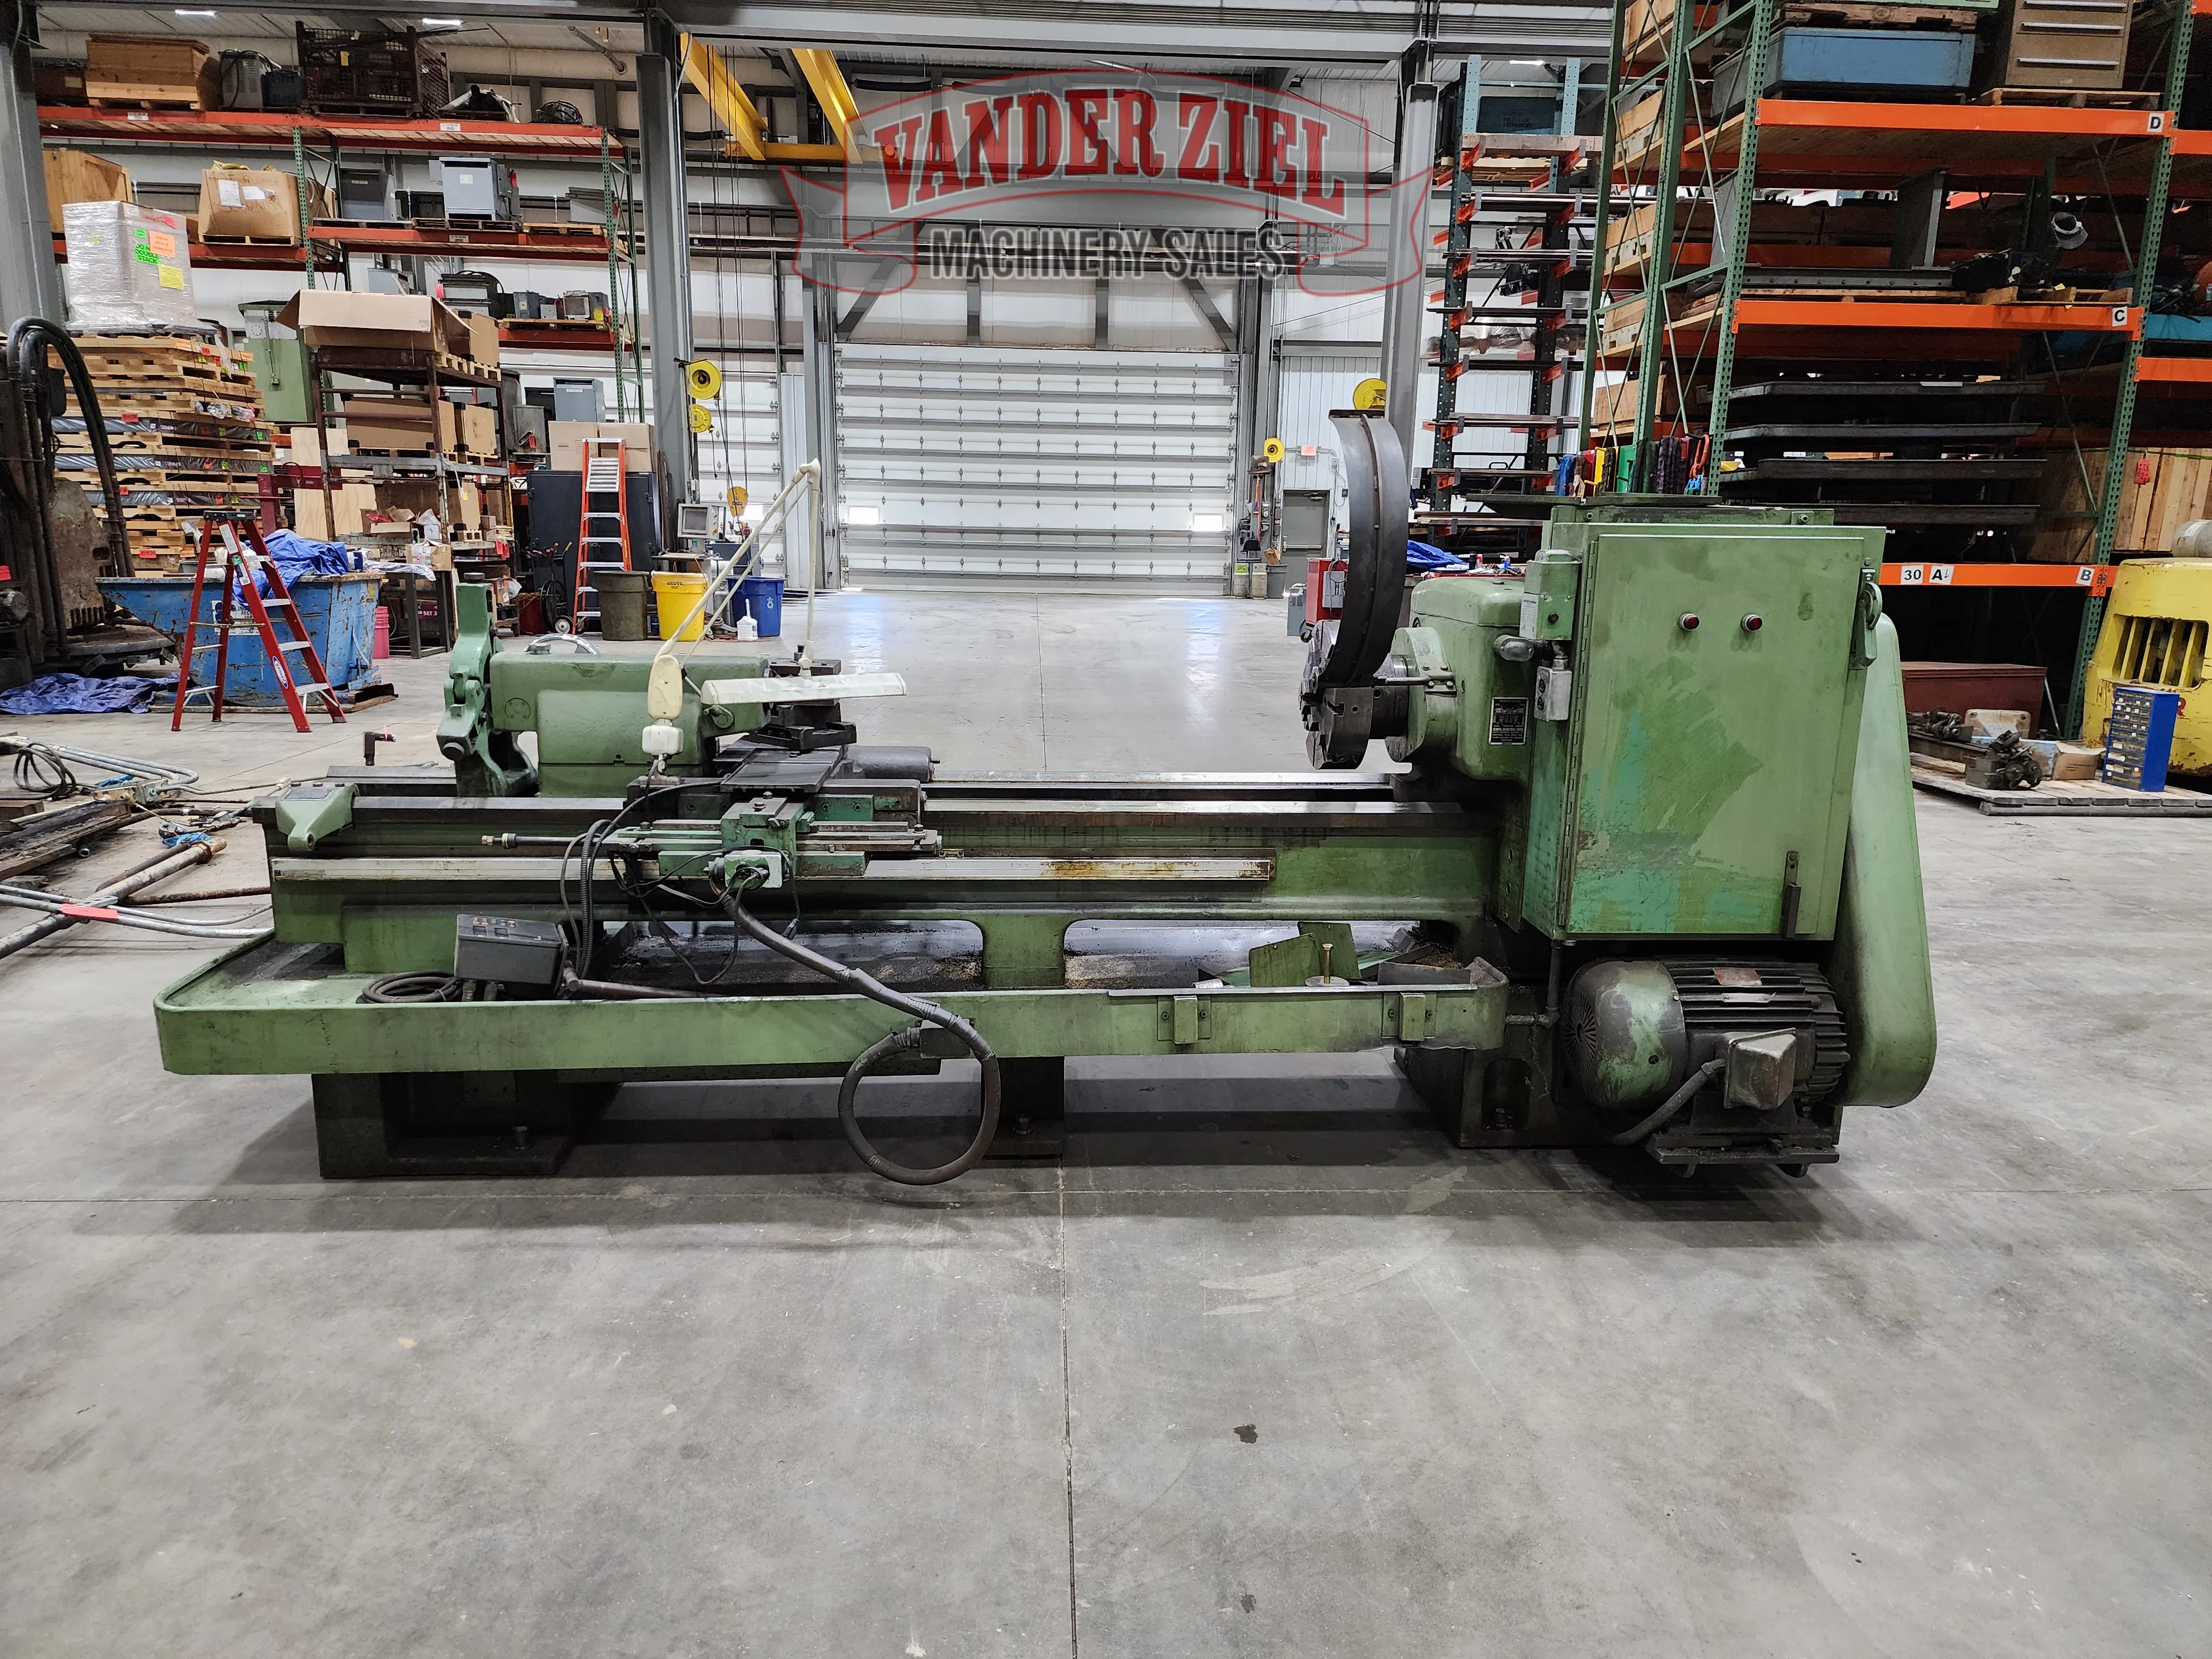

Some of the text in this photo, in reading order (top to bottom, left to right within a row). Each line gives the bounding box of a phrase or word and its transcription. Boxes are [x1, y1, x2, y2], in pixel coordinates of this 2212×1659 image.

[2150, 116, 2161, 129] D
[135, 249, 159, 259] DOUBLE
[137, 255, 158, 264] STACK
[2114, 310, 2125, 322] C
[1904, 569, 1943, 581] 30 A
[2080, 569, 2091, 581] B
